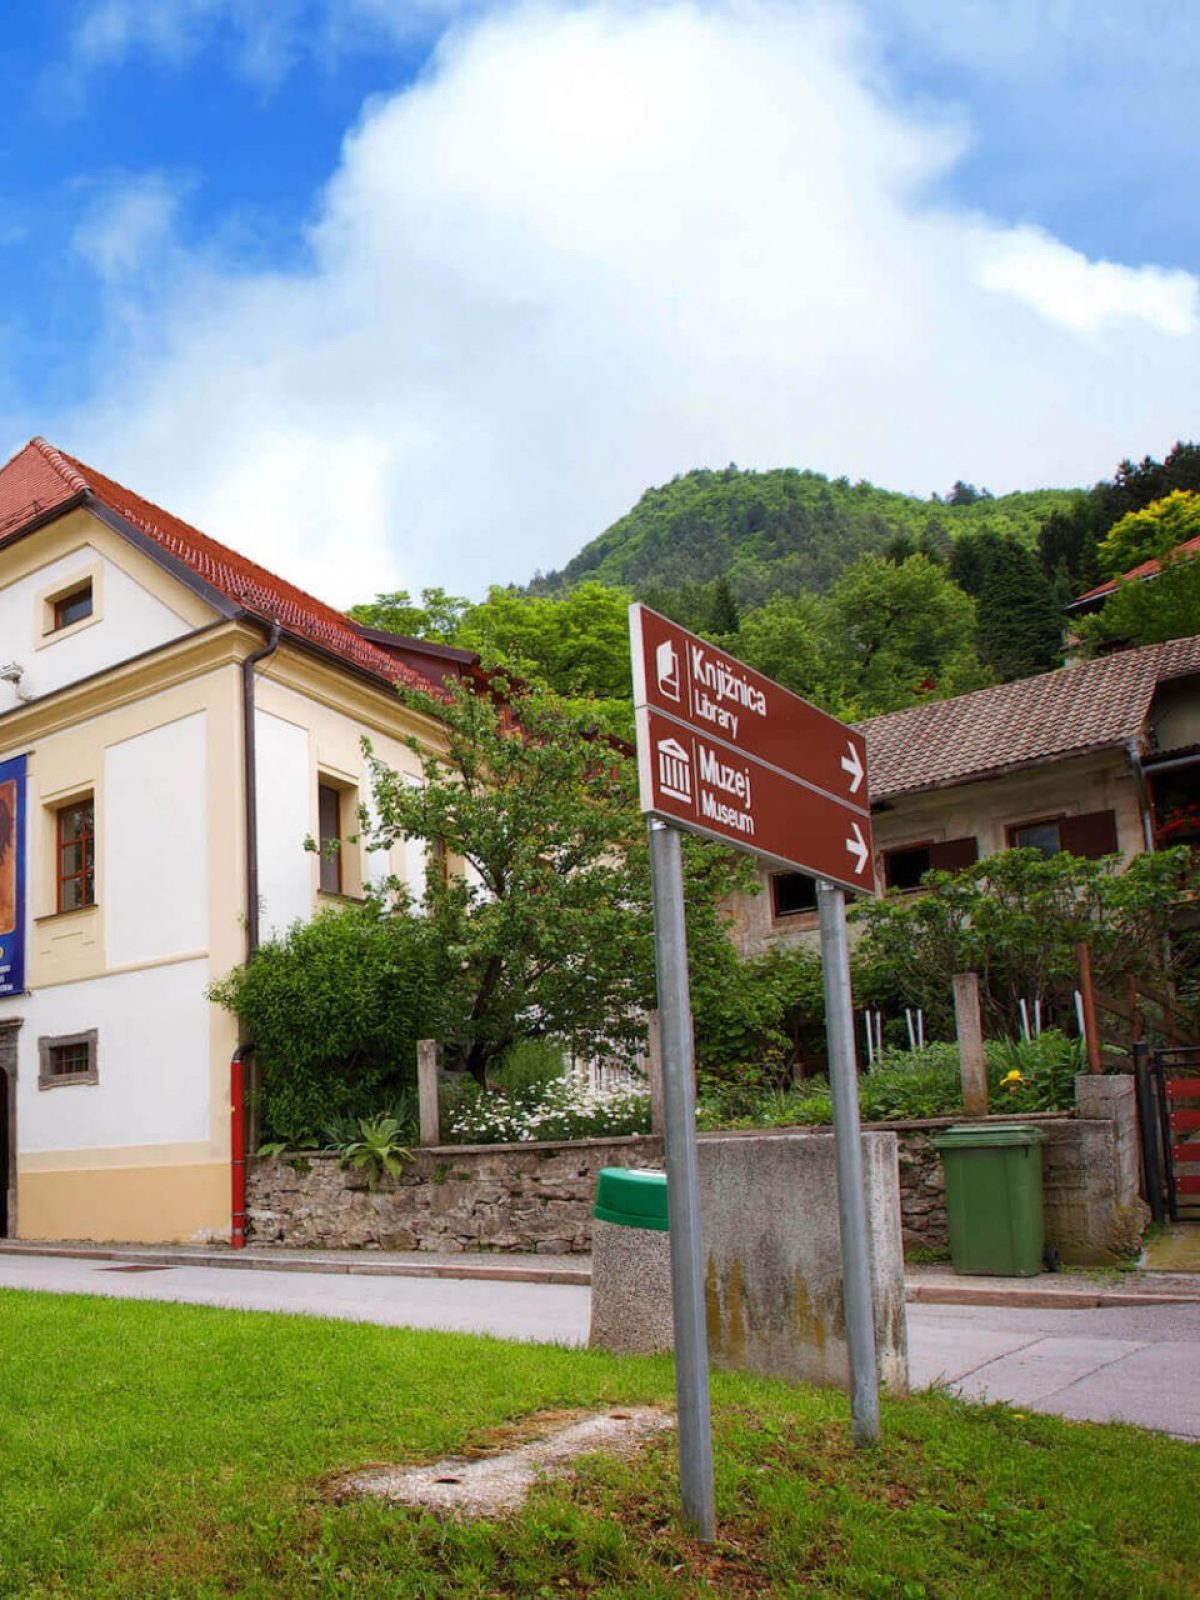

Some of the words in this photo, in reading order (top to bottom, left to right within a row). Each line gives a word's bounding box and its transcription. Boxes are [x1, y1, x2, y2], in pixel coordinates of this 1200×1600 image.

[692, 646, 766, 716] Knjižnica
[695, 689, 738, 739] Library
[699, 745, 751, 808] Muzej
[702, 789, 755, 835] Museum
